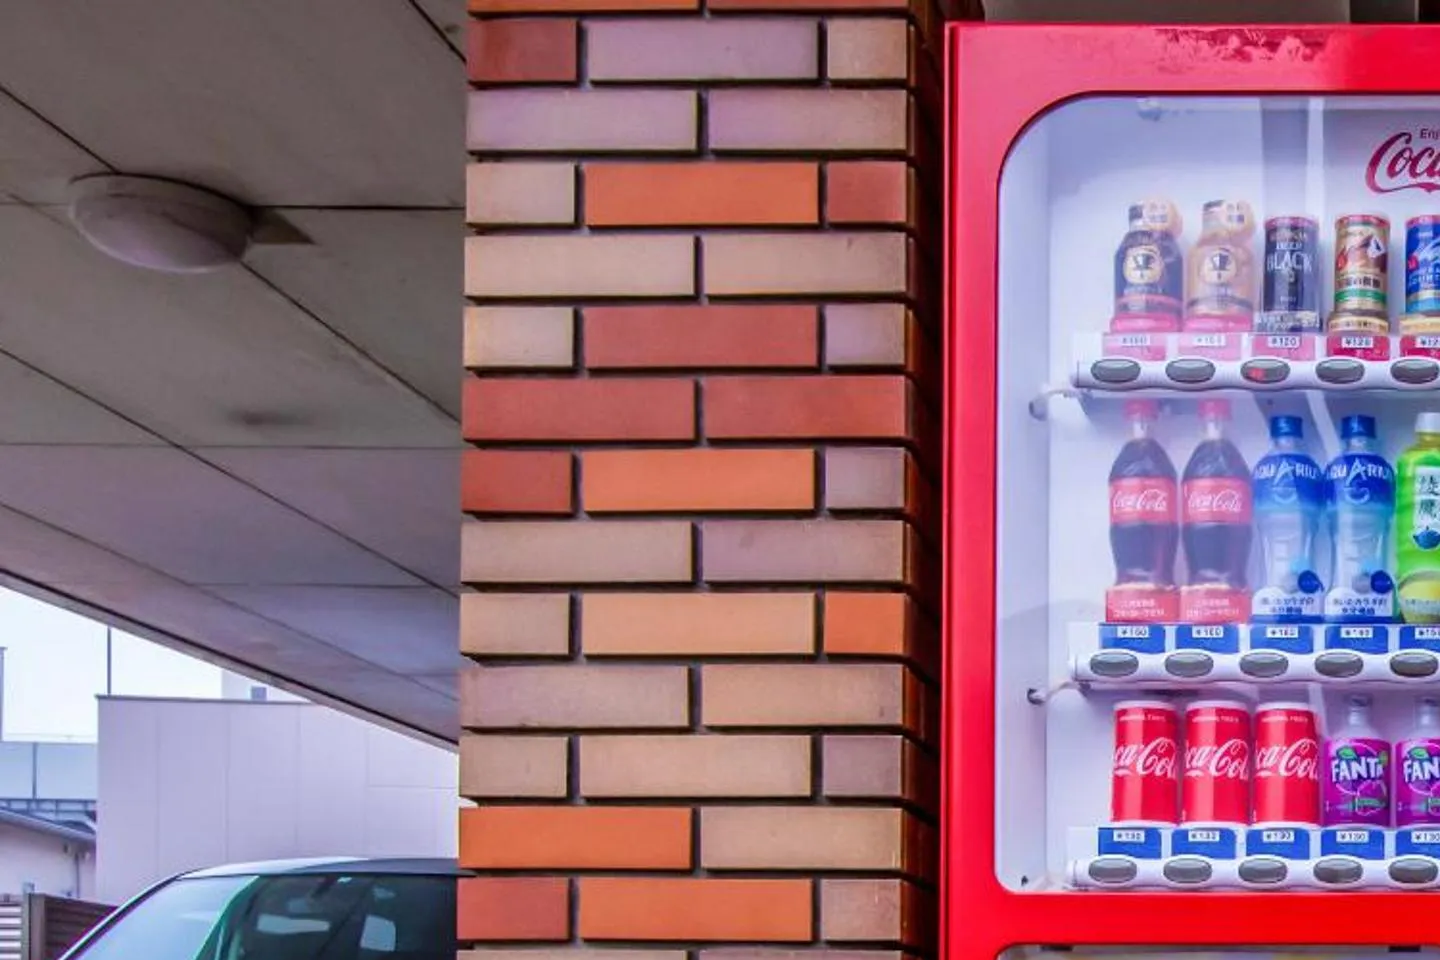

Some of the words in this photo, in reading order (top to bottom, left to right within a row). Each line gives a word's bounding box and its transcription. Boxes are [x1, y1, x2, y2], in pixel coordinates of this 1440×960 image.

[1113, 488, 1168, 511] Coca-Cola
[1187, 489, 1242, 512] Coca-Cola
[1331, 757, 1384, 783] FANTA
